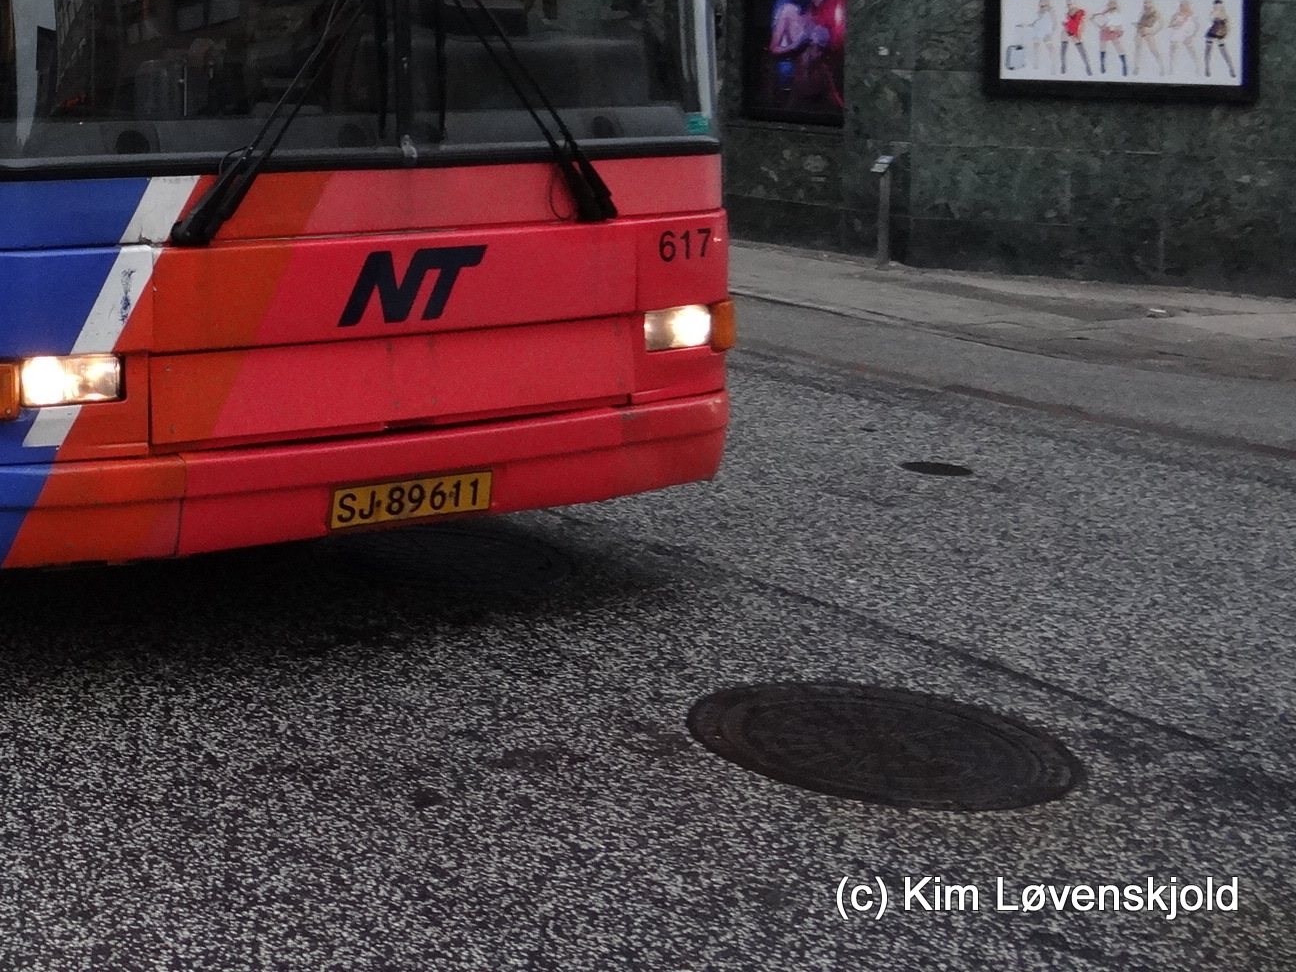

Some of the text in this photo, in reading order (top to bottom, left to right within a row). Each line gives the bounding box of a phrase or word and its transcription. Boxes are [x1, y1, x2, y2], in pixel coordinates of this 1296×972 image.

[658, 228, 712, 262] 617
[338, 245, 488, 328] NT
[337, 491, 377, 523] SJ
